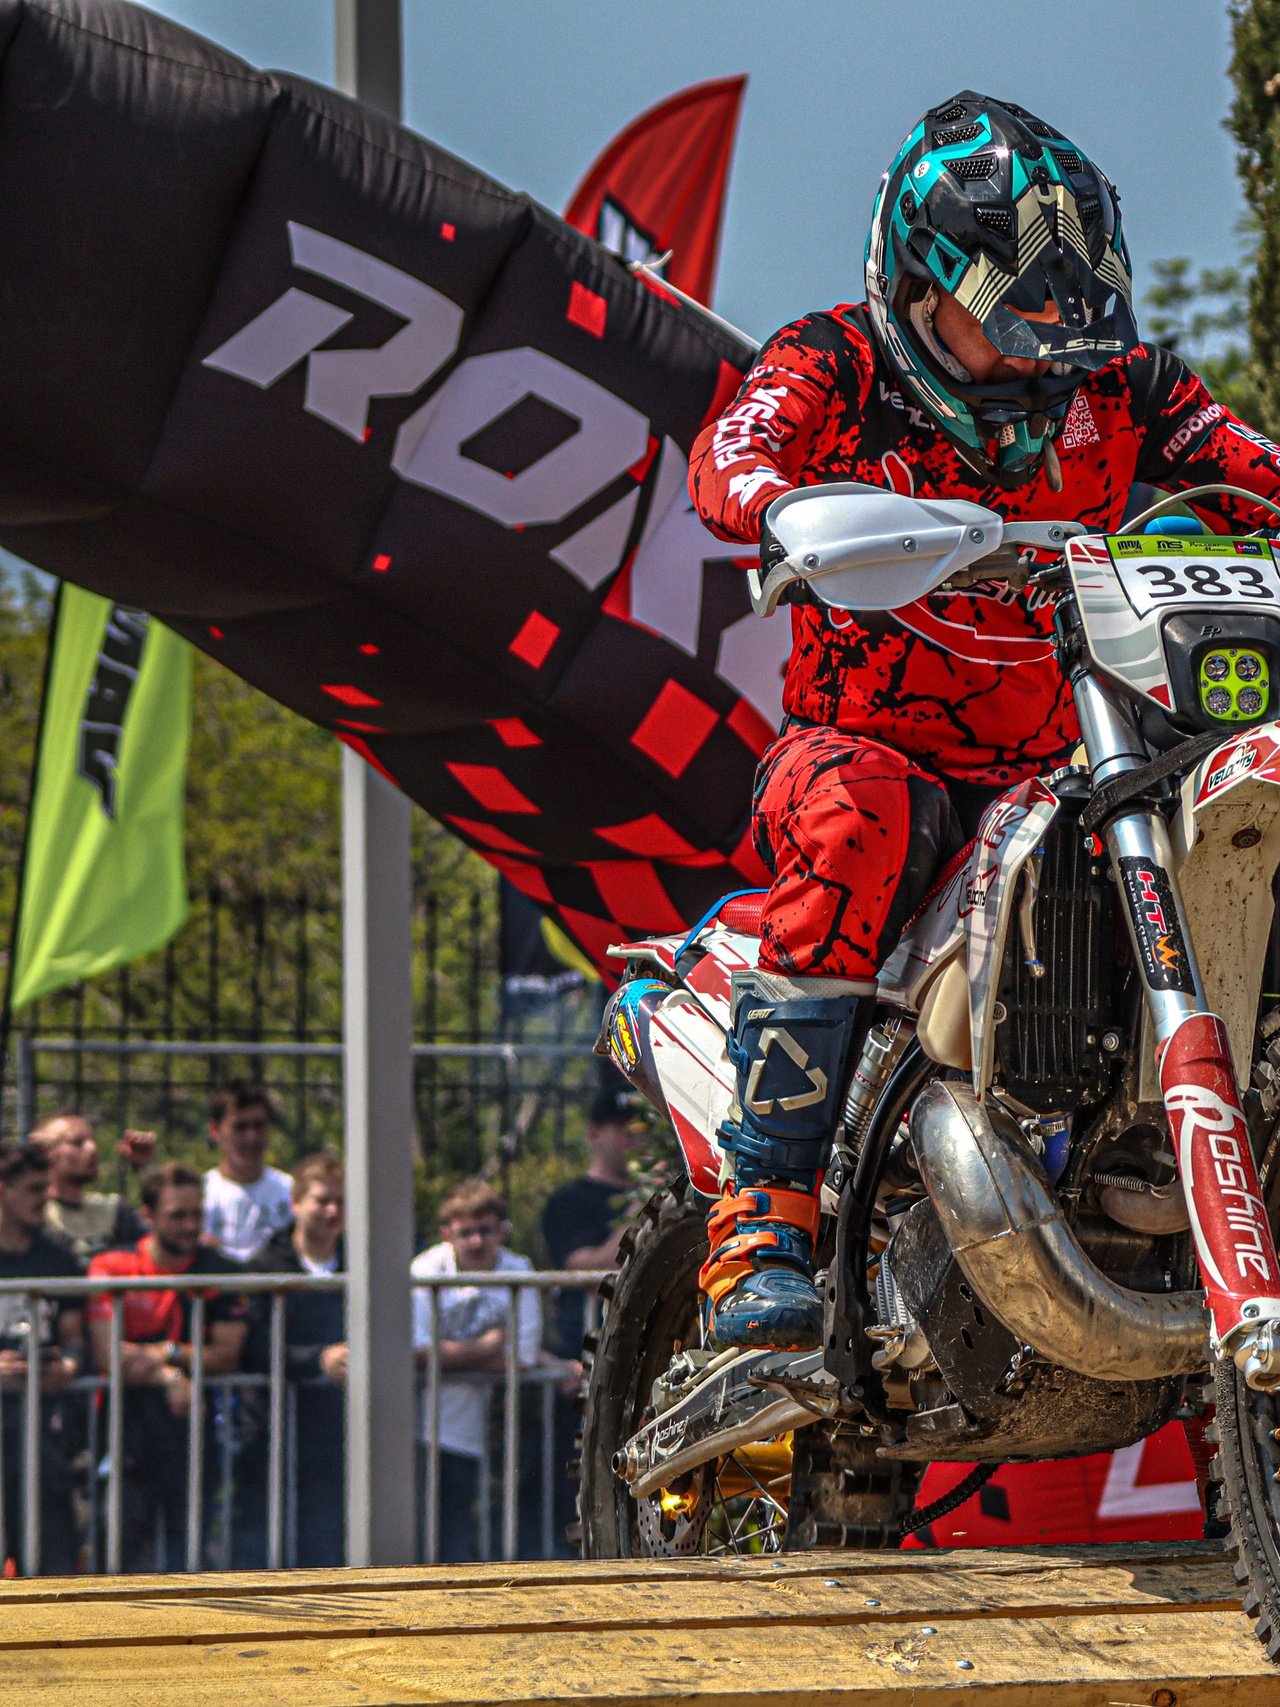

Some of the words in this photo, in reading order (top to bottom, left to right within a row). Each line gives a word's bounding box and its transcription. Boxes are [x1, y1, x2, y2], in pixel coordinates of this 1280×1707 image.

[1136, 565, 1275, 599] 383
[1208, 751, 1256, 789] VELOCITY
[747, 1008, 776, 1020] LEATT
